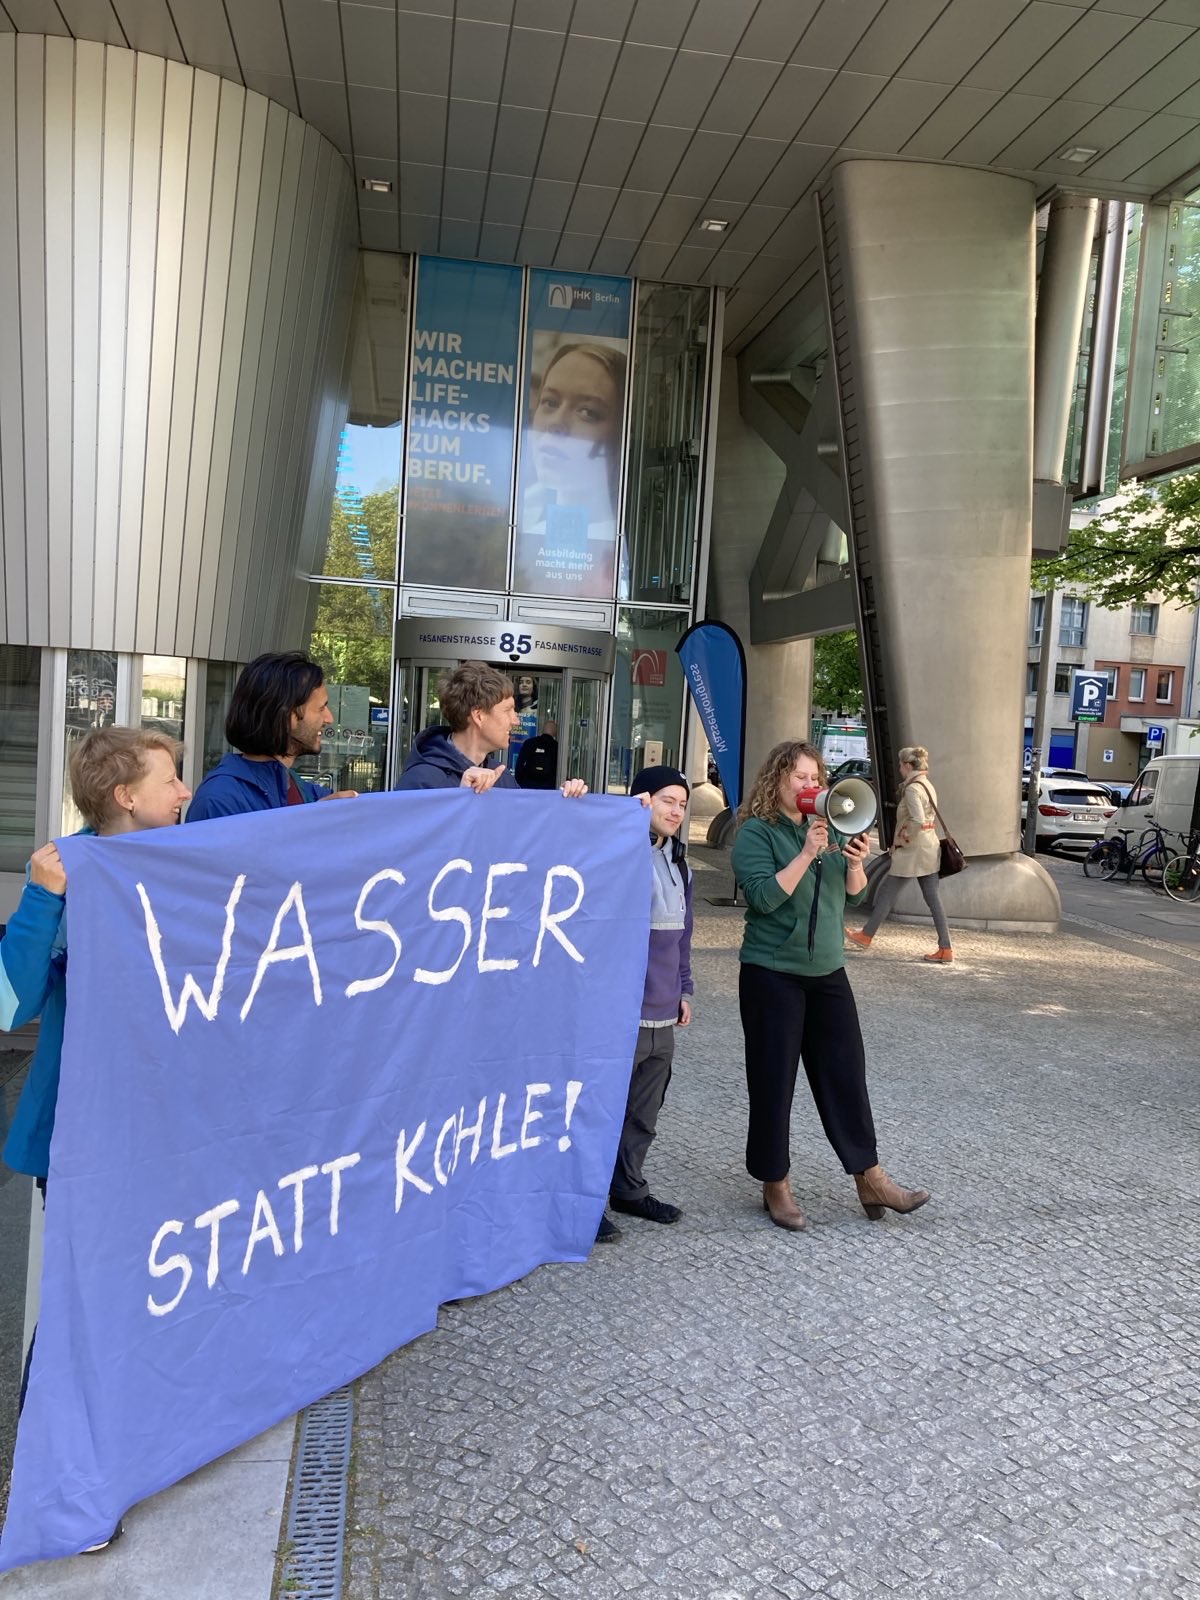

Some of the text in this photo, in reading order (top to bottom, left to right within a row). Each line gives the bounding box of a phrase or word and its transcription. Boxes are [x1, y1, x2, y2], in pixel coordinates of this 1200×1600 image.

[574, 288, 620, 304] IHK Berlin
[415, 330, 463, 353] WIR
[412, 355, 514, 385] MACHEN
[411, 383, 469, 405] LIFE-
[410, 406, 491, 434] HACKS
[409, 434, 461, 456] ZUM
[407, 457, 492, 486] BERUF.
[535, 560, 595, 571] macht mehr
[537, 547, 593, 561] Ausbildung
[545, 571, 583, 581] aus uns
[419, 632, 603, 657] FASANENSTRASSE 85 FASANENSTRASSE
[1083, 684, 1100, 707] P
[1151, 728, 1160, 740] P
[135, 857, 586, 1036] WASSER
[146, 1079, 584, 1318] STATT KOHLE!
